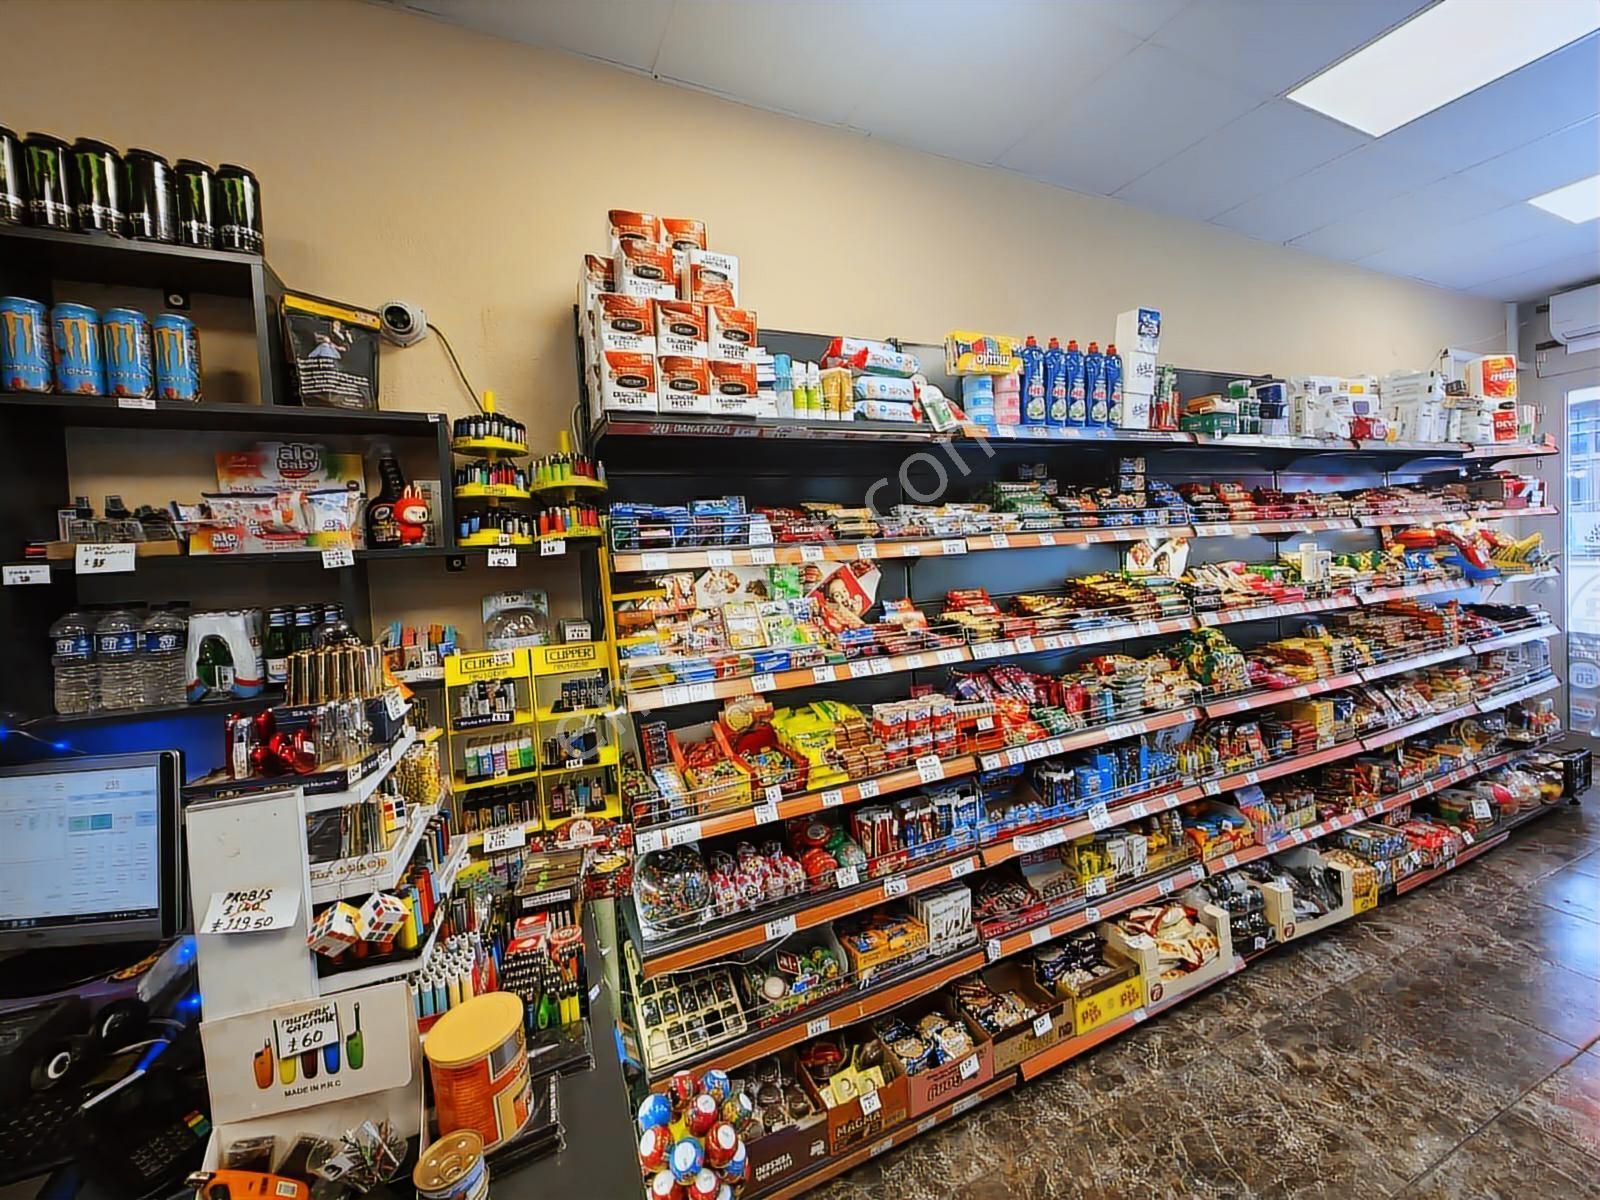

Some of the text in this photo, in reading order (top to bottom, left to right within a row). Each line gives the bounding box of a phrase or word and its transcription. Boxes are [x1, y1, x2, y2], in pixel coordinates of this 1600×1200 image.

[548, 647, 592, 661] CLIPPER
[284, 1086, 309, 1097] MADE
[835, 1110, 882, 1138] MAGMA
